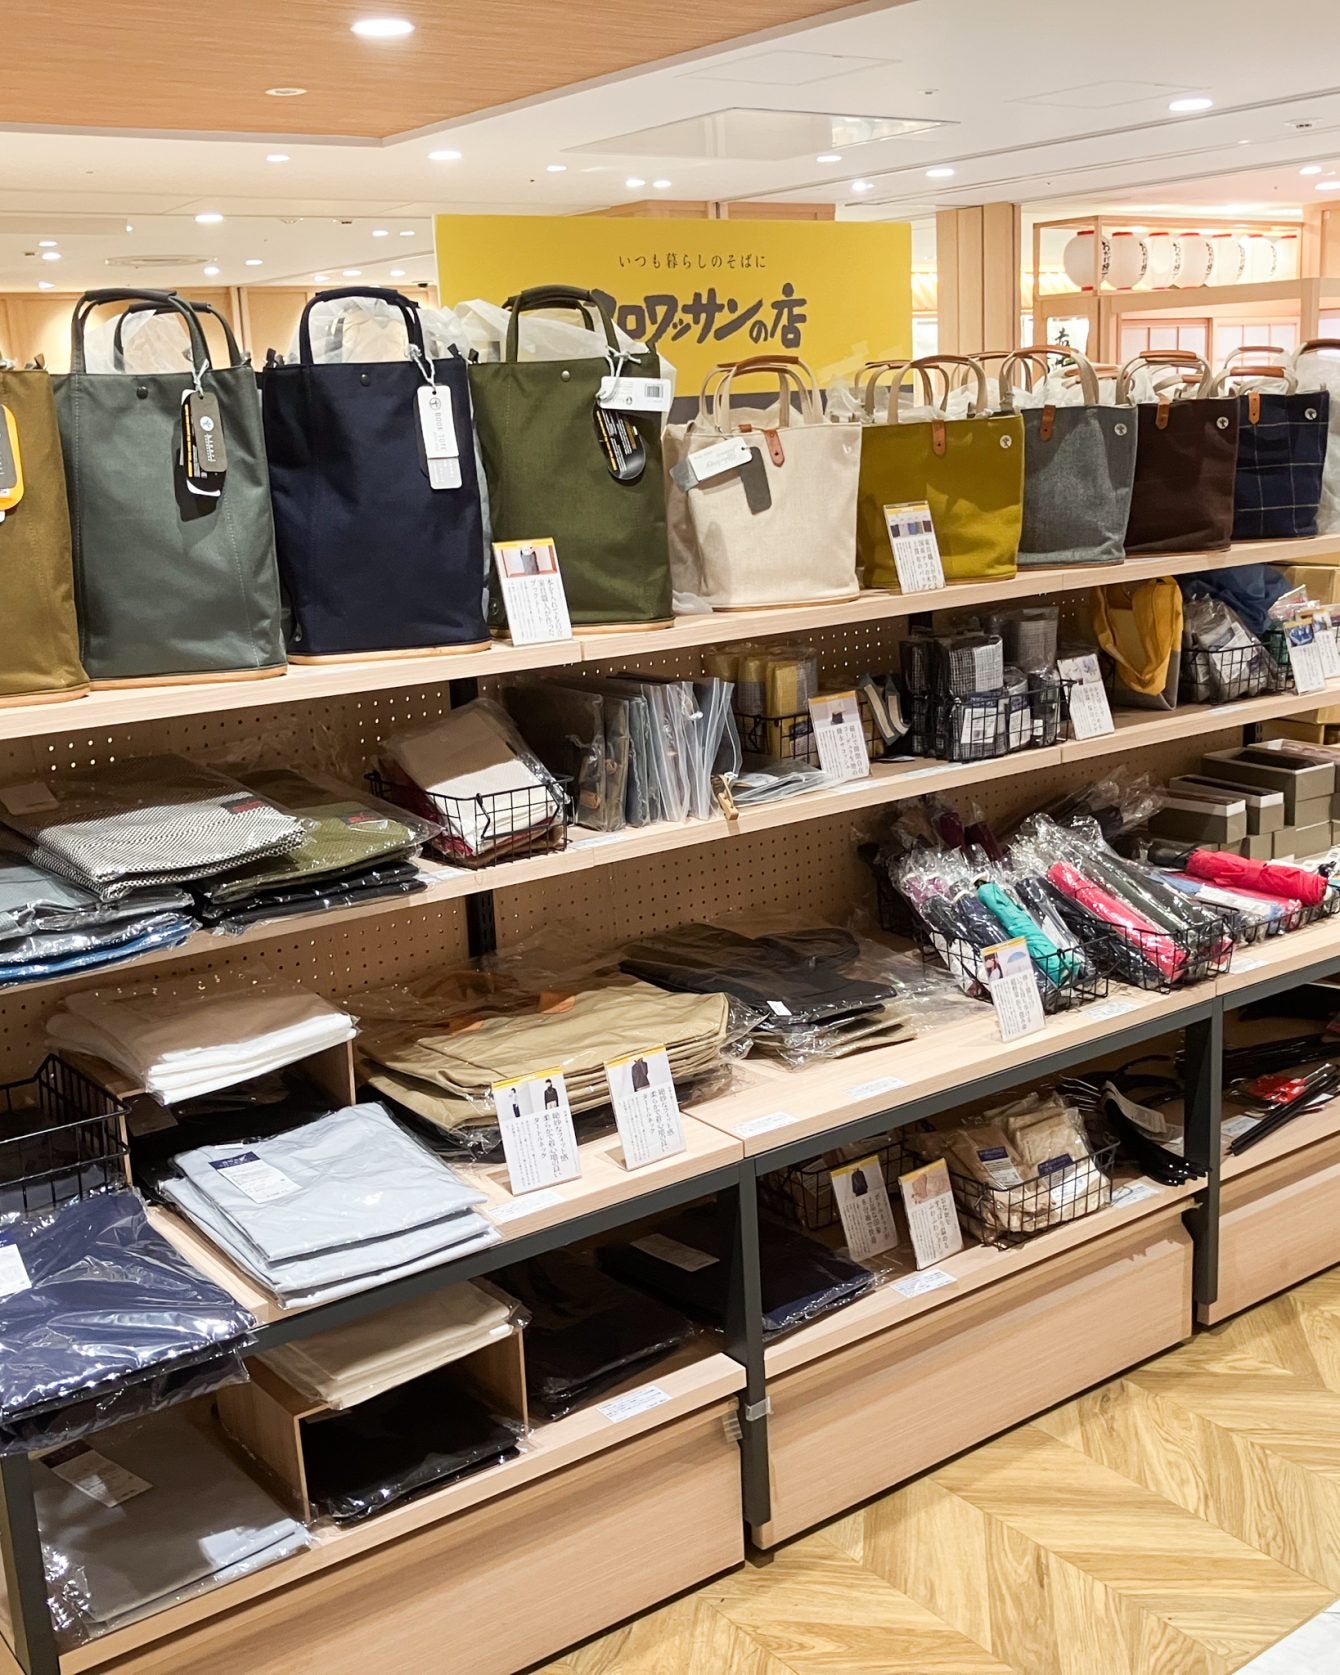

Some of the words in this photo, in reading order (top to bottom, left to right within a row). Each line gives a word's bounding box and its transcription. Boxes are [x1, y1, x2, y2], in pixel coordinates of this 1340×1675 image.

[618, 253, 766, 269] いつも暮らしのそばに
